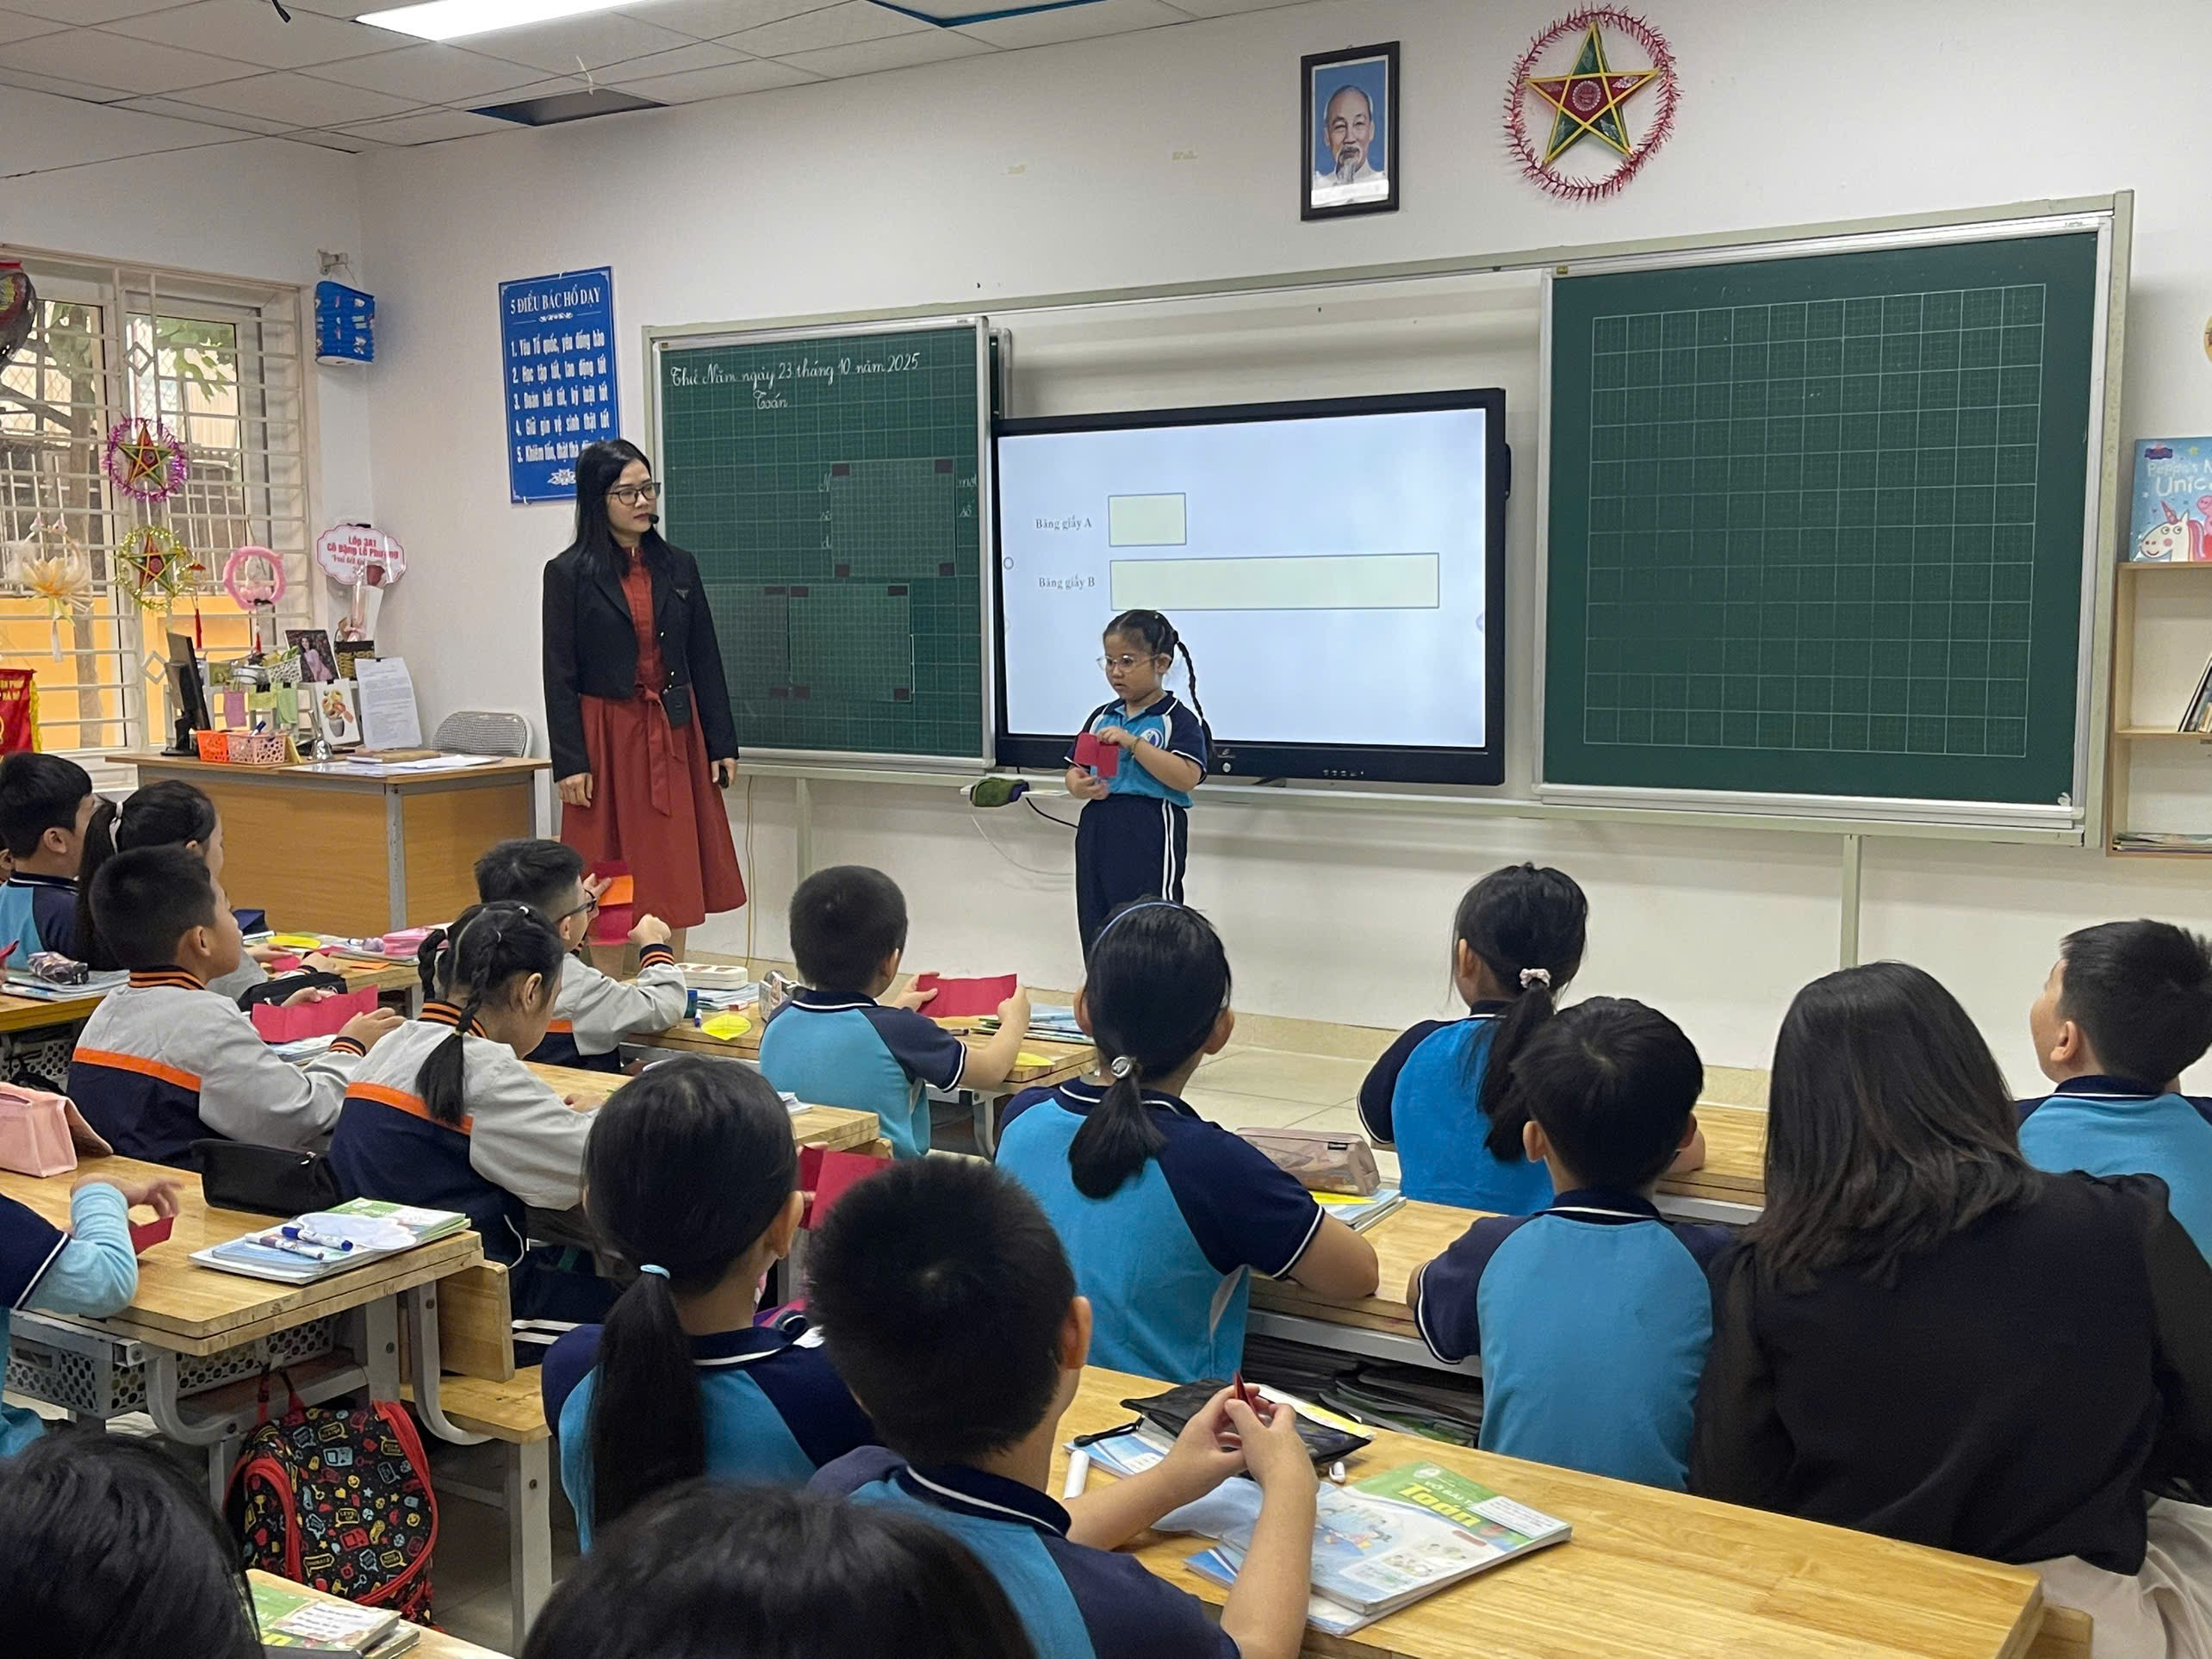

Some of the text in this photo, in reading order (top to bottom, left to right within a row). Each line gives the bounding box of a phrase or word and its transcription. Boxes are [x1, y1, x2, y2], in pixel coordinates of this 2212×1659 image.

[510, 283, 600, 314] 5 ĐIỀU BÁC HỒ DẠY
[670, 352, 921, 390] Thứ Năm ngày 23 tháng 10 năm 2025
[752, 389, 789, 410] Toán
[2156, 475, 2212, 497] Unic
[1061, 514, 1082, 531] giấy
[1084, 517, 1092, 528] A
[1065, 574, 1084, 590] giấy
[1088, 576, 1095, 587] B
[1398, 1482, 1482, 1528] Toán
